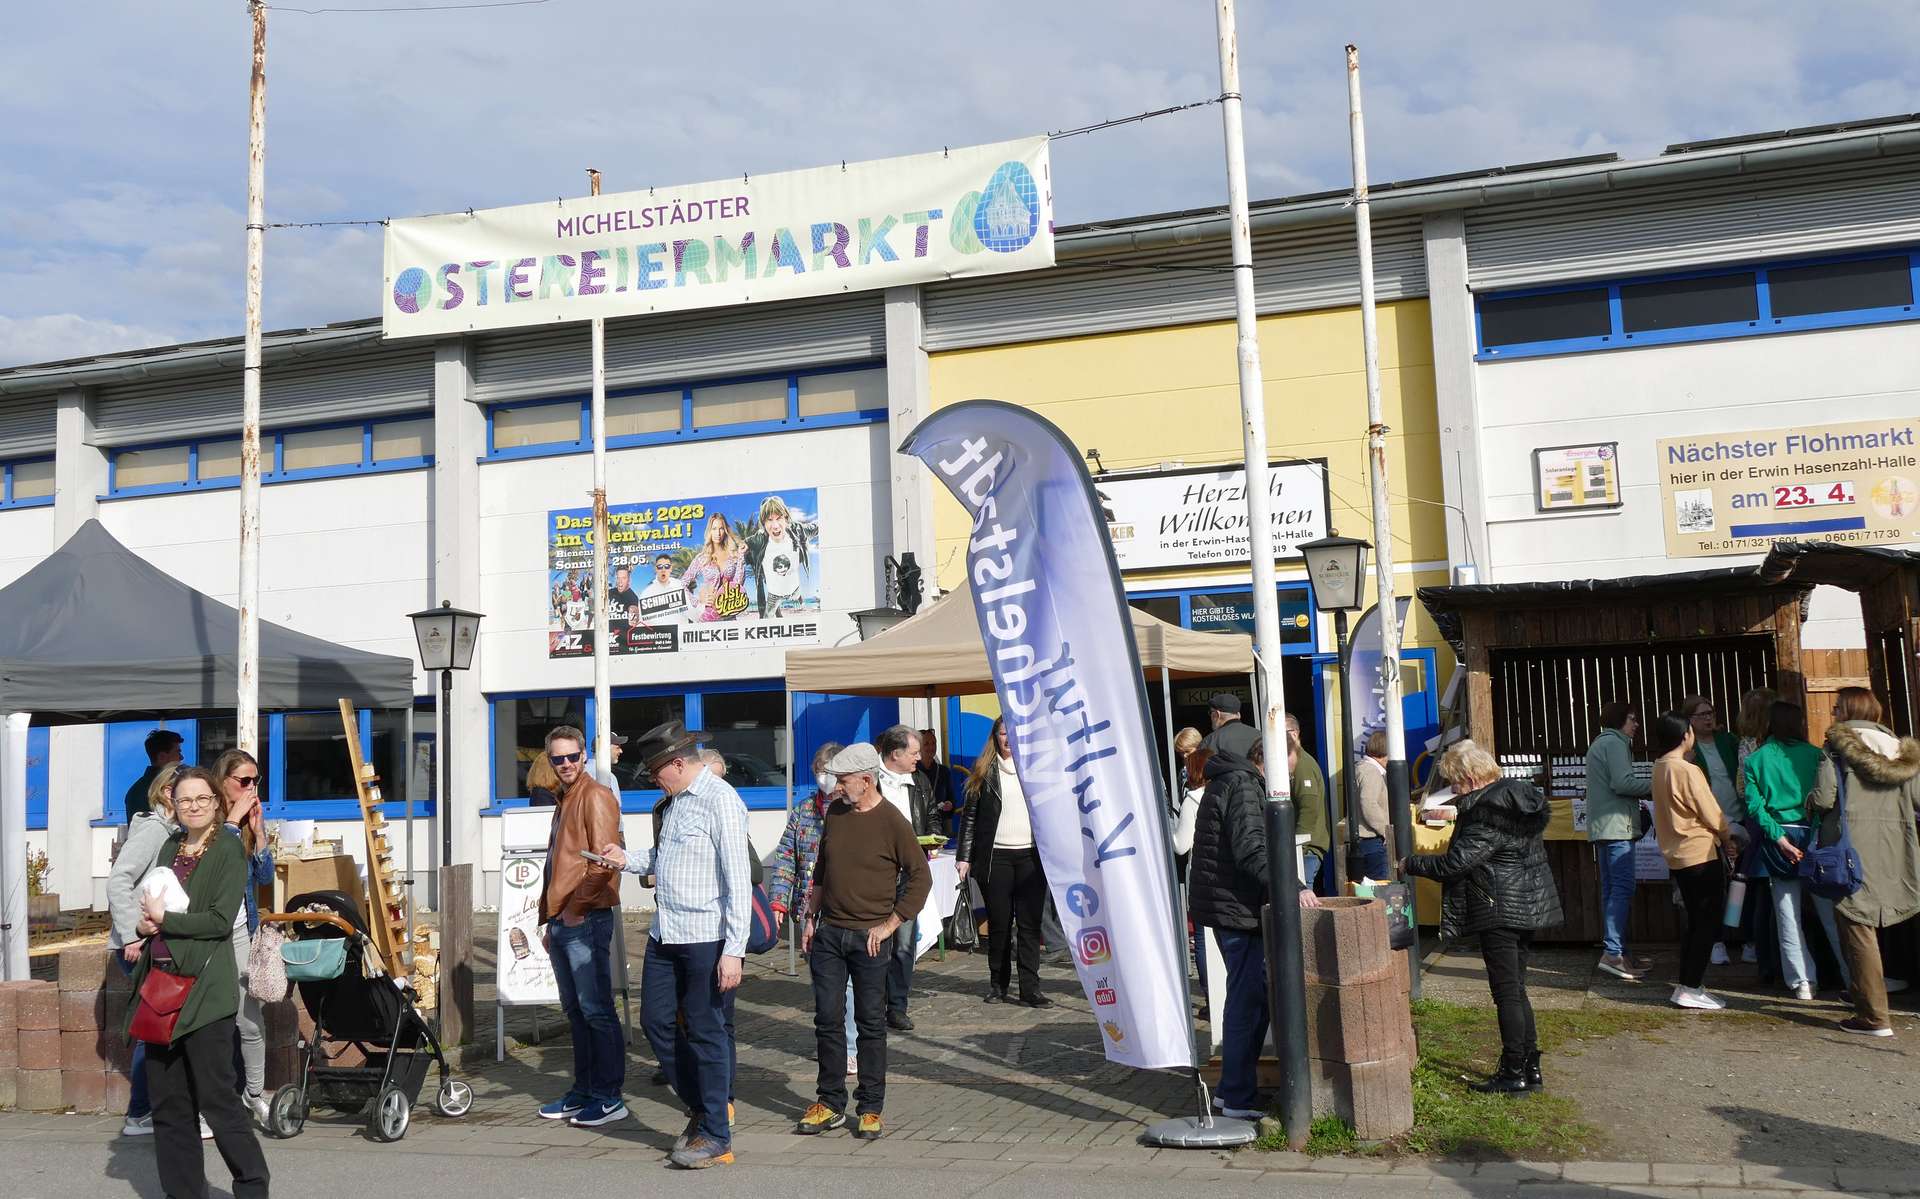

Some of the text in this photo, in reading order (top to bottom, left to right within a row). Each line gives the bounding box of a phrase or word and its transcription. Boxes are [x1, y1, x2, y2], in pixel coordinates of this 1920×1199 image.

[556, 196, 750, 238] MICHELSTÄDTER
[393, 208, 943, 314] OSTEREIERMARKT
[1668, 427, 1914, 465] Nächster Flohmarkt
[1670, 453, 1916, 485] hier in der Erwin Hasenzahl-Halle
[1731, 482, 1855, 509] am 23. 4.
[556, 515, 592, 531] Das
[656, 504, 705, 522] 2023
[555, 533, 582, 548] im
[623, 541, 681, 553] Michelstadt
[1160, 540, 1170, 549] in
[1172, 537, 1189, 548] der
[1698, 541, 1719, 551] Tel.:
[612, 554, 649, 567] 28.05.
[1187, 549, 1222, 560] Telefon
[1192, 606, 1235, 616] HIER GIBT ES
[1192, 613, 1239, 623] KOSTENLOSES
[682, 623, 817, 644] MICKIE KRAUSE
[556, 634, 583, 651] AZ
